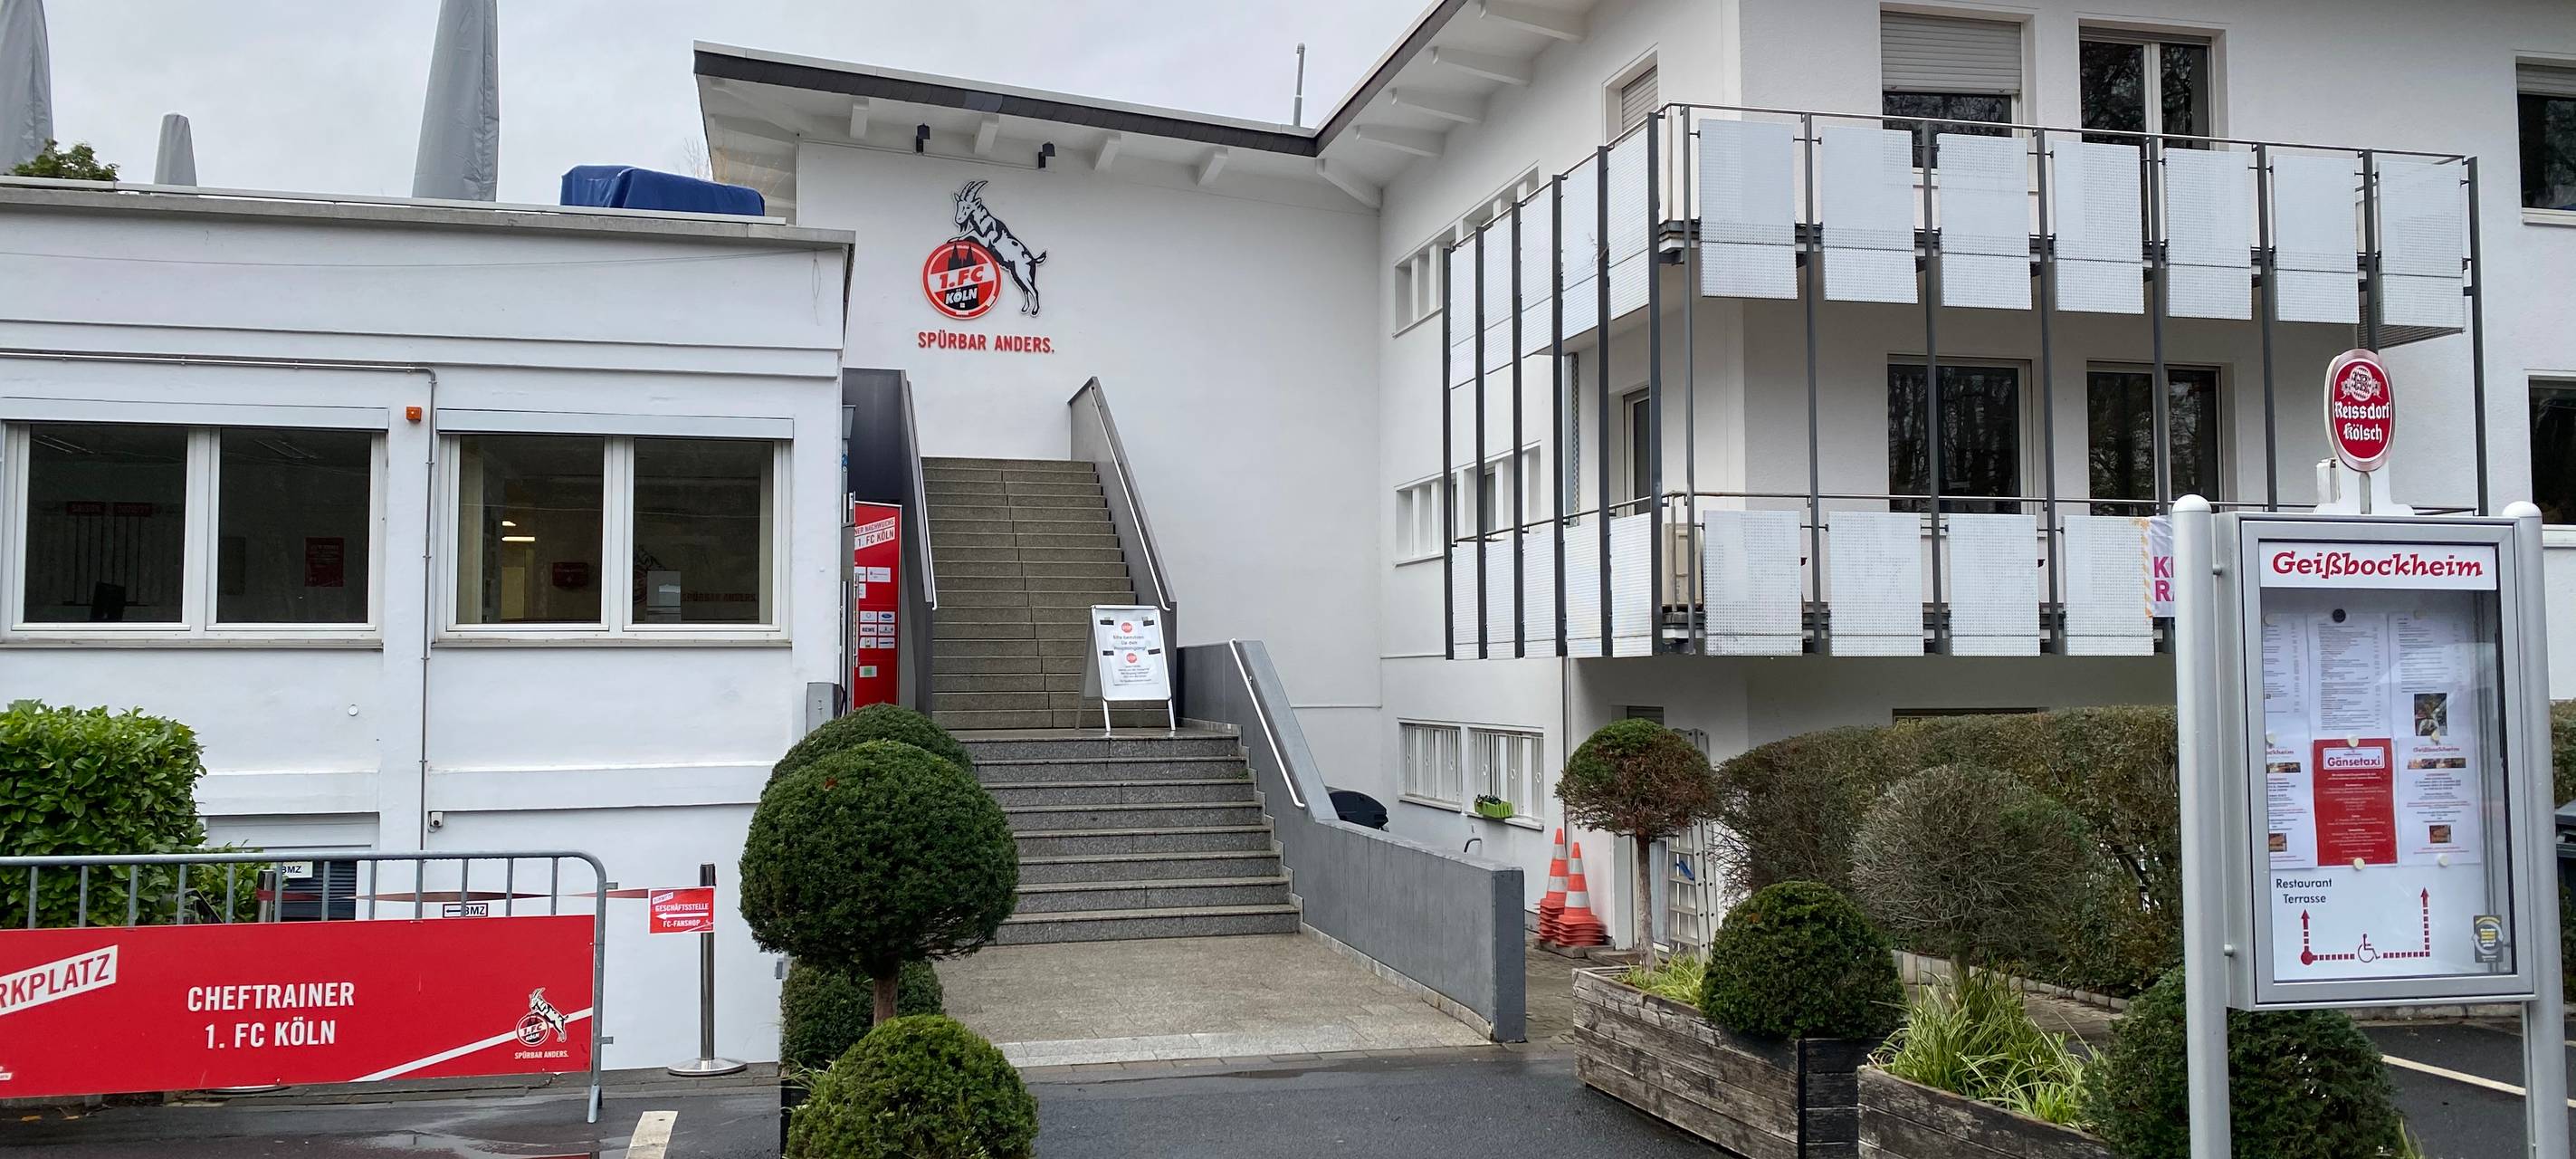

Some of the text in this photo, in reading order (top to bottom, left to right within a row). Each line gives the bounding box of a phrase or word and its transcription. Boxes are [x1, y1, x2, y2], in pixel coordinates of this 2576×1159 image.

[940, 265, 985, 290] 1.FC
[945, 287, 978, 305] KÖLN
[918, 330, 1055, 354] SPÜRBAR ANDERS.
[2334, 401, 2390, 420] Reissdorf
[2343, 423, 2383, 444] Kölsch
[866, 534, 875, 545] FC
[877, 527, 894, 542] KÖLN
[2273, 551, 2483, 579] Geißbockheim
[2327, 755, 2380, 767] Gänsetaxi
[2275, 877, 2333, 888] Restaurant
[654, 903, 710, 912] GESCHÄFTSSTELLE
[2283, 894, 2326, 904] Terrasse
[663, 919, 701, 928] FC-FANSHOP
[187, 982, 355, 1011] CHEFTRAINER
[205, 1016, 336, 1049] 1. FC KÖLN
[514, 1050, 569, 1060] SPÜRBAR ANDERS.
